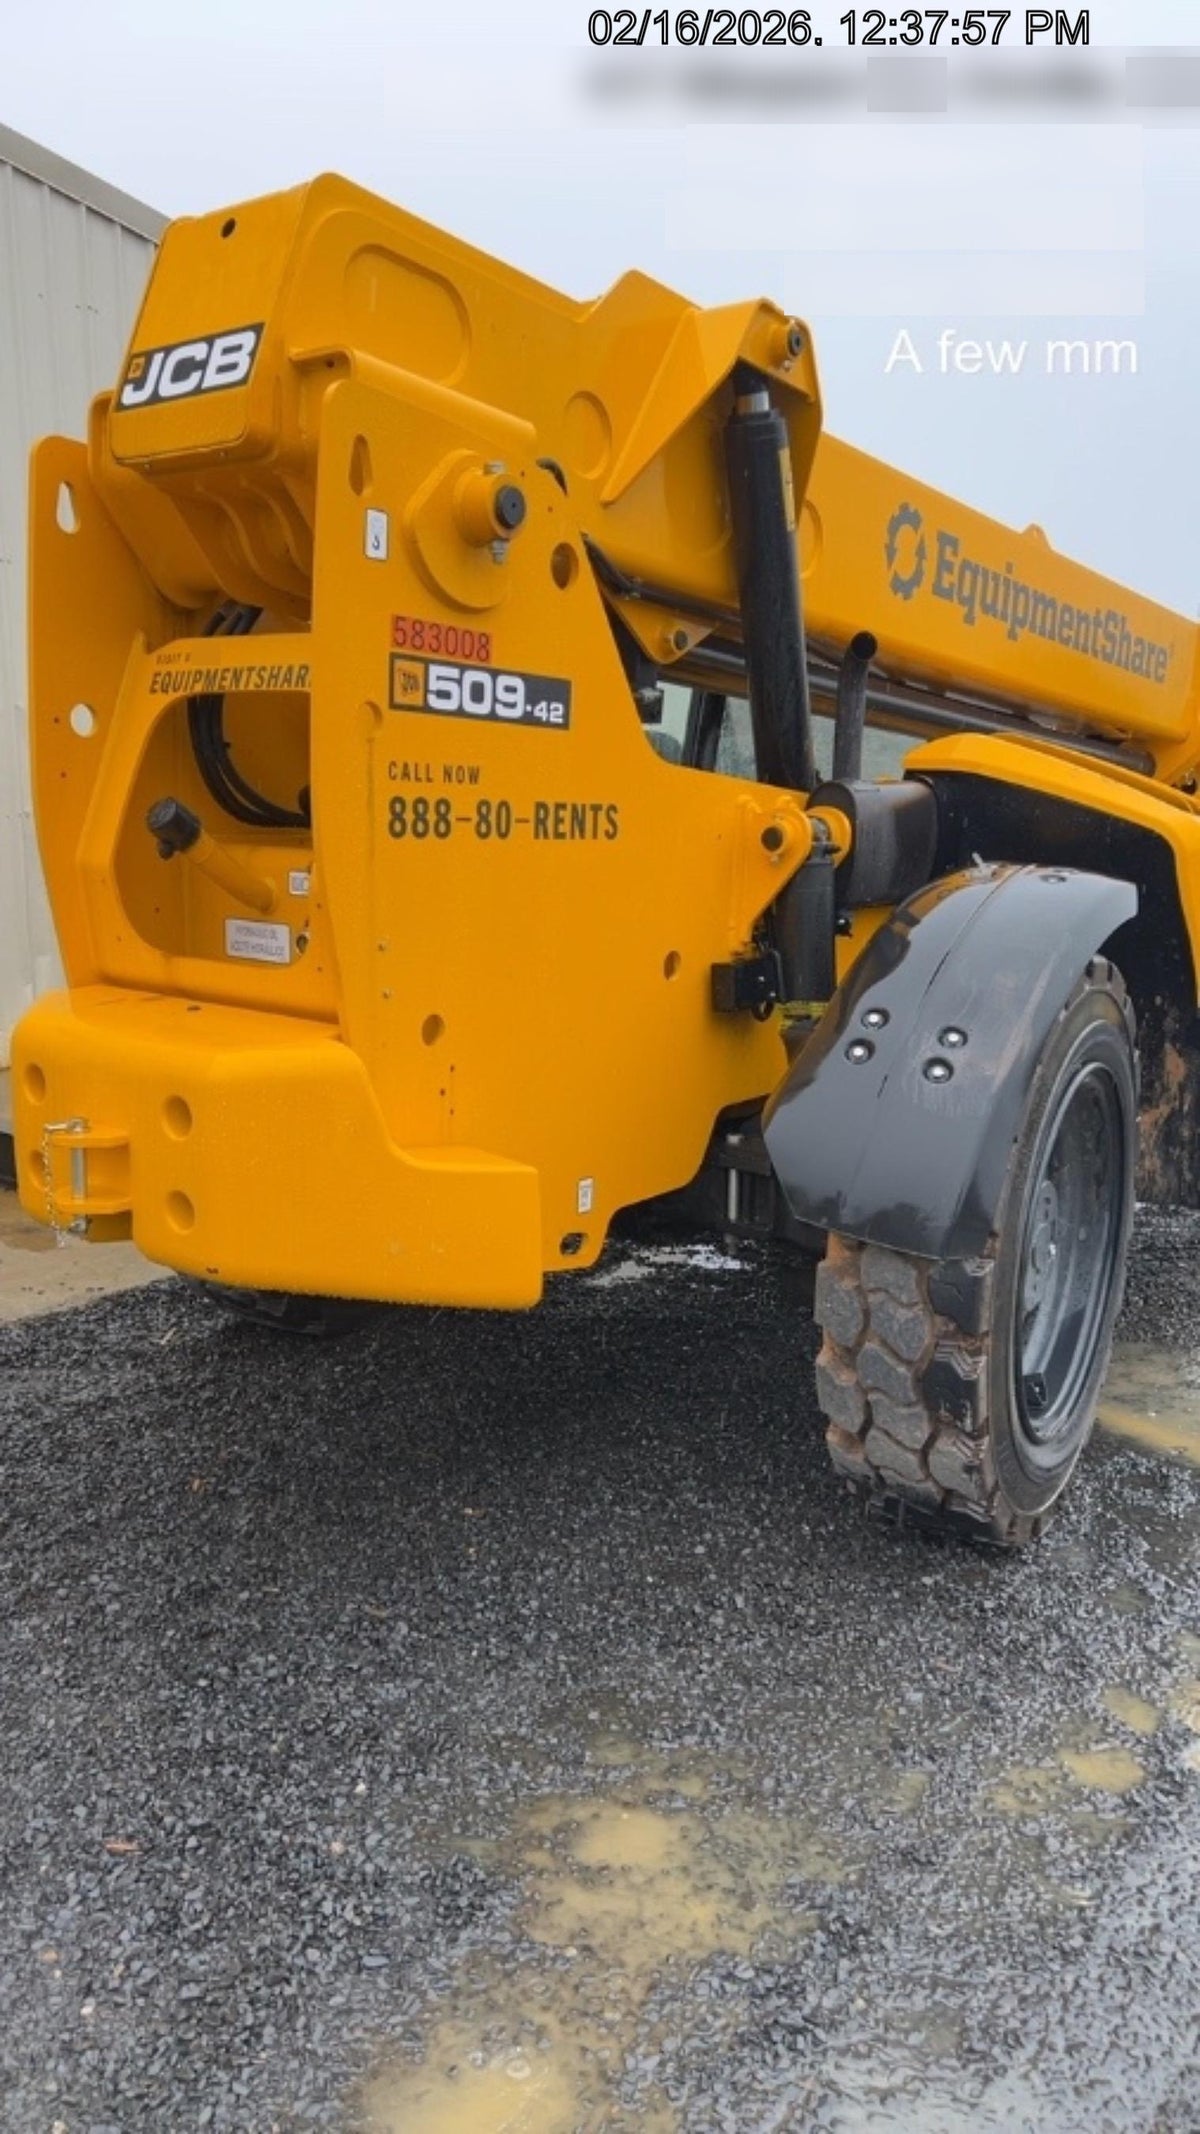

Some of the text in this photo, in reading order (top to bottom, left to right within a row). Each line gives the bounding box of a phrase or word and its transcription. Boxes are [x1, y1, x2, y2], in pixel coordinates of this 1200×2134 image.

[120, 330, 257, 407] JCB
[931, 530, 1170, 683] EquipmentShare
[394, 616, 490, 662] 583008
[149, 665, 311, 694] EQUIPMENTSHAR
[388, 760, 480, 785] CALL NOW
[388, 796, 619, 840] 888-80-RENTS
